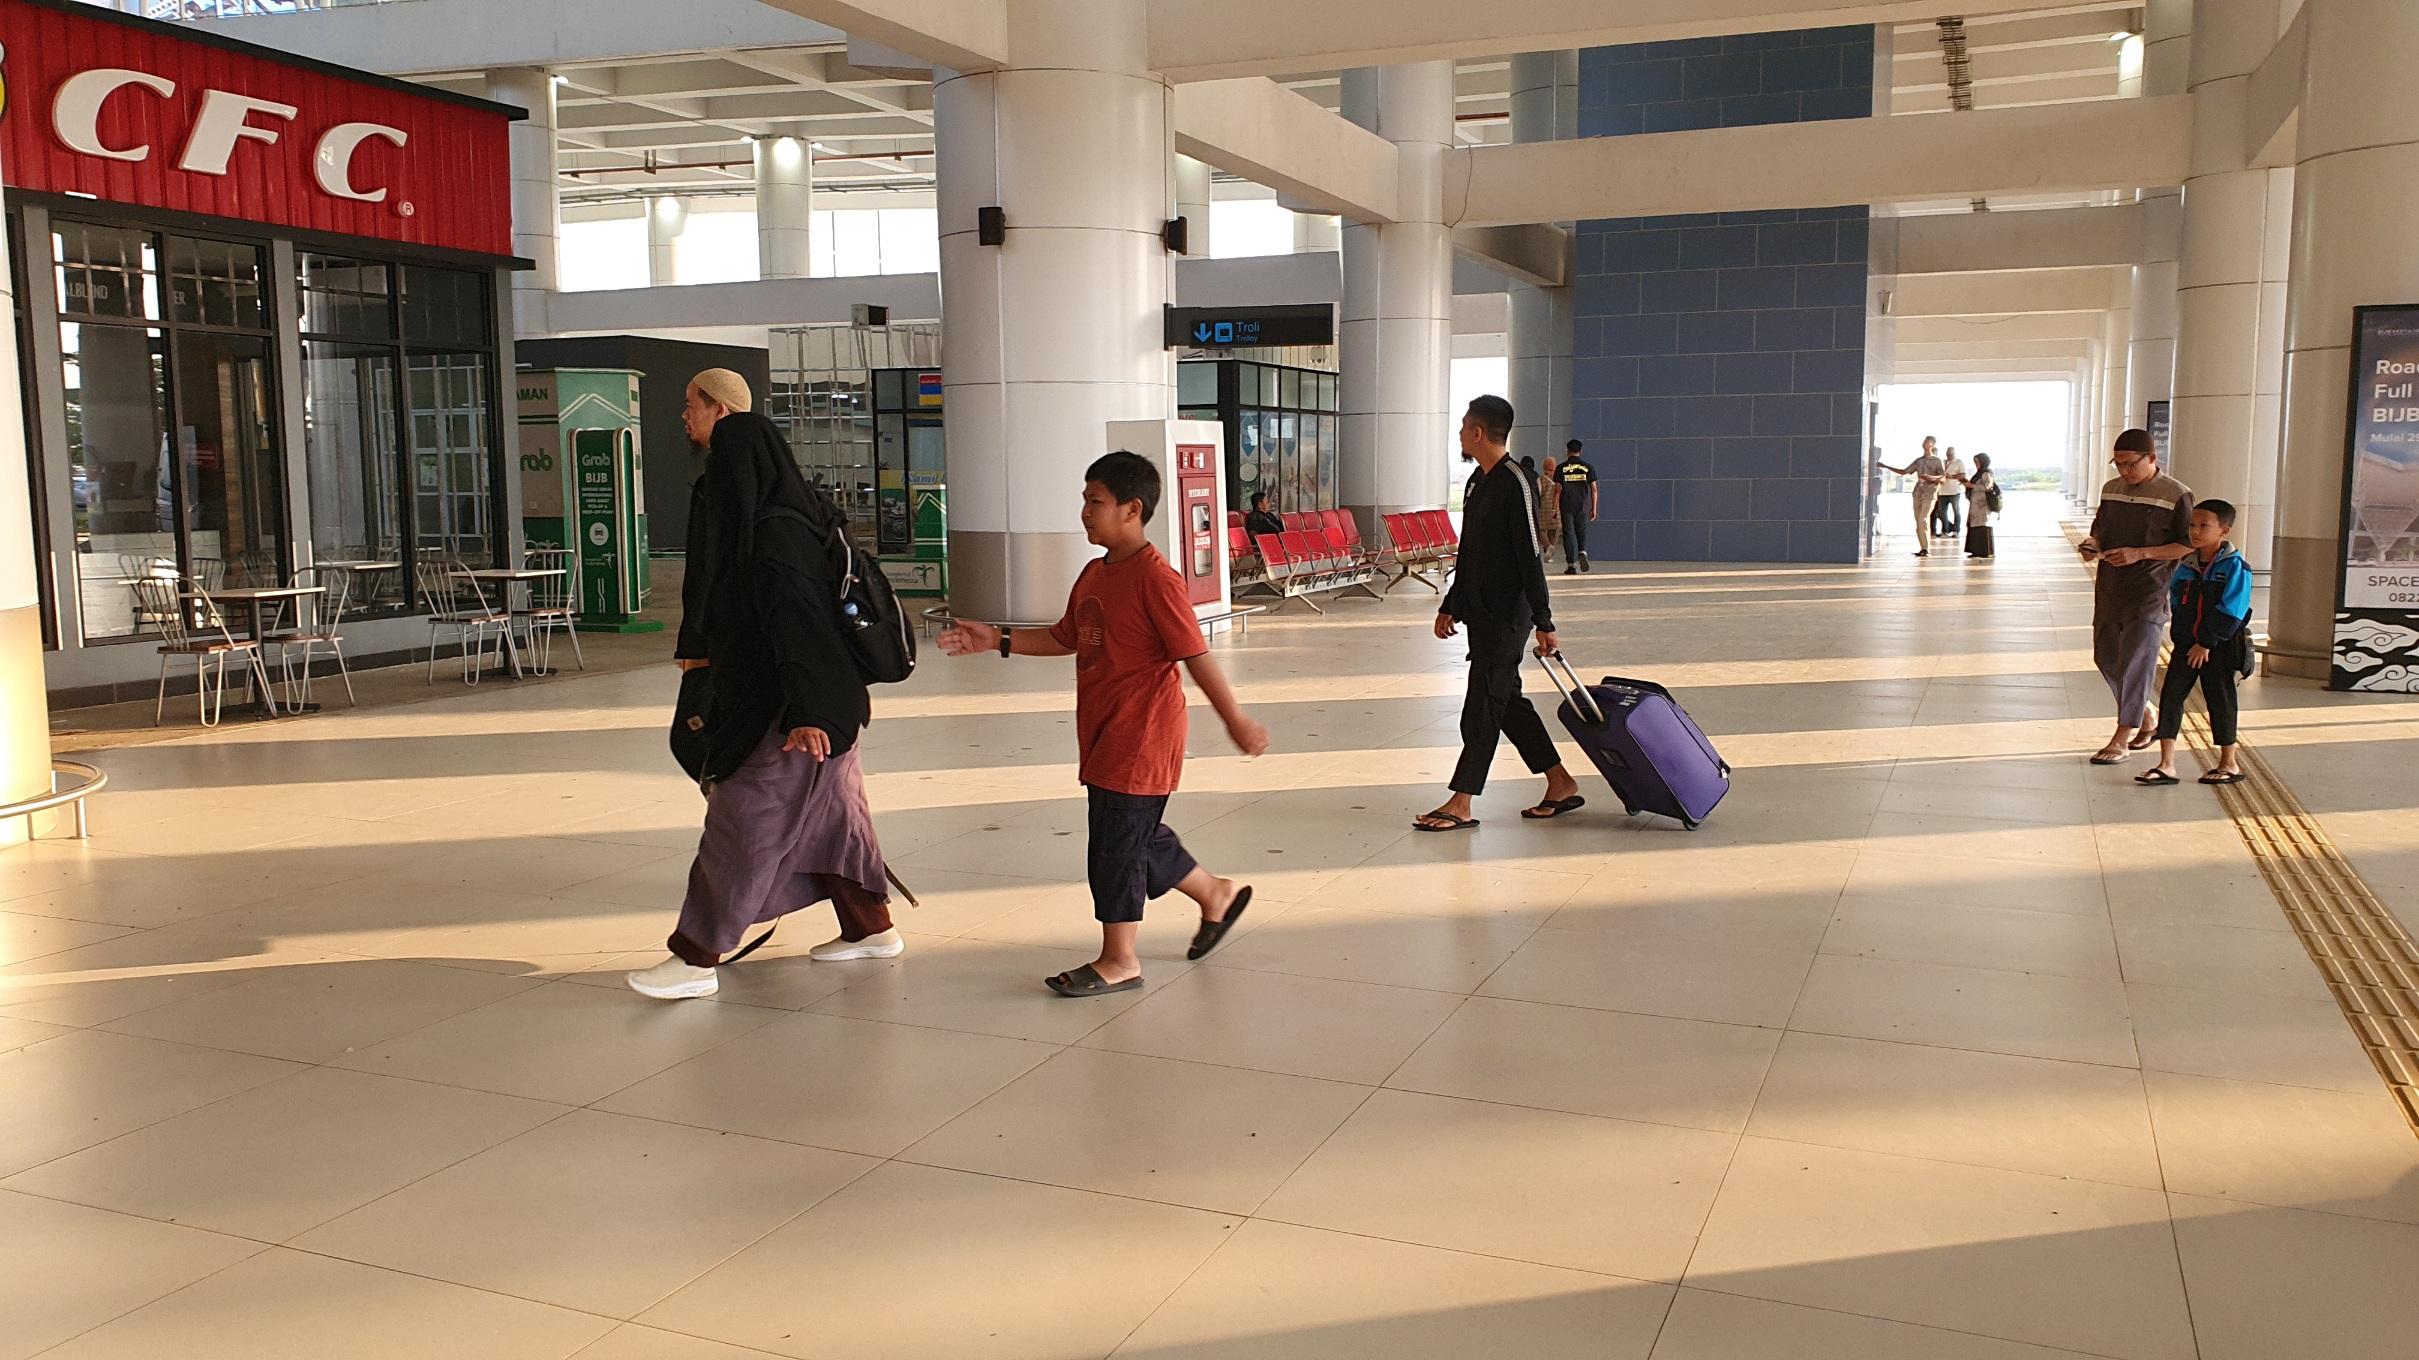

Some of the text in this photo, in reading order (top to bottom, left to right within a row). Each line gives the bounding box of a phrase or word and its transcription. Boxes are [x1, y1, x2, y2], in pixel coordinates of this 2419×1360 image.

[52, 68, 408, 203] CFC
[1237, 321, 1260, 333] Troli
[2375, 359, 2419, 375] Roa
[2373, 383, 2413, 399] Full
[2372, 407, 2419, 423] BIJB
[519, 447, 554, 472] rab
[581, 452, 611, 467] Grab
[585, 472, 608, 483] BIJB
[2367, 575, 2419, 588] SPACE
